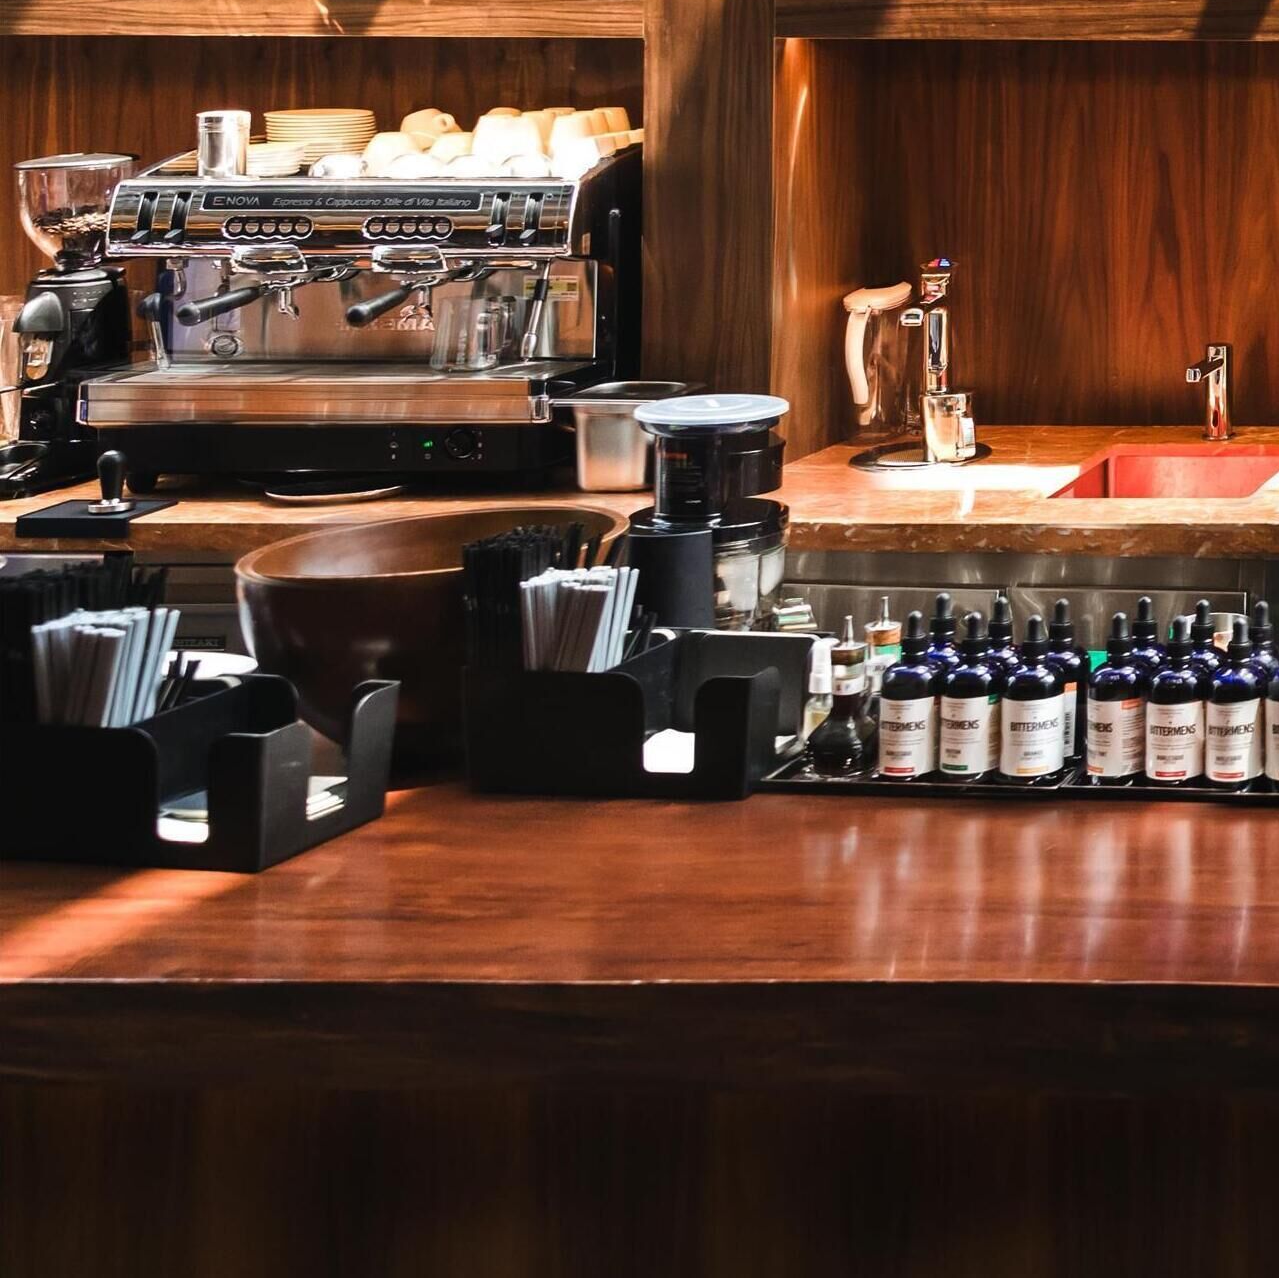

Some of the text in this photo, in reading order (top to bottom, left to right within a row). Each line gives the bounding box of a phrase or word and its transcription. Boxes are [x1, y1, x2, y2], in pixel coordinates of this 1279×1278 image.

[272, 197, 313, 207] Espresso
[325, 196, 380, 207] Cappuccino
[382, 196, 403, 206] Stile
[416, 196, 435, 206] Vita
[436, 196, 472, 207] Italiano
[1010, 718, 1058, 732] BITTERMENS
[1149, 723, 1196, 737] BITTERMENS
[1207, 722, 1255, 737] BITTERMENS
